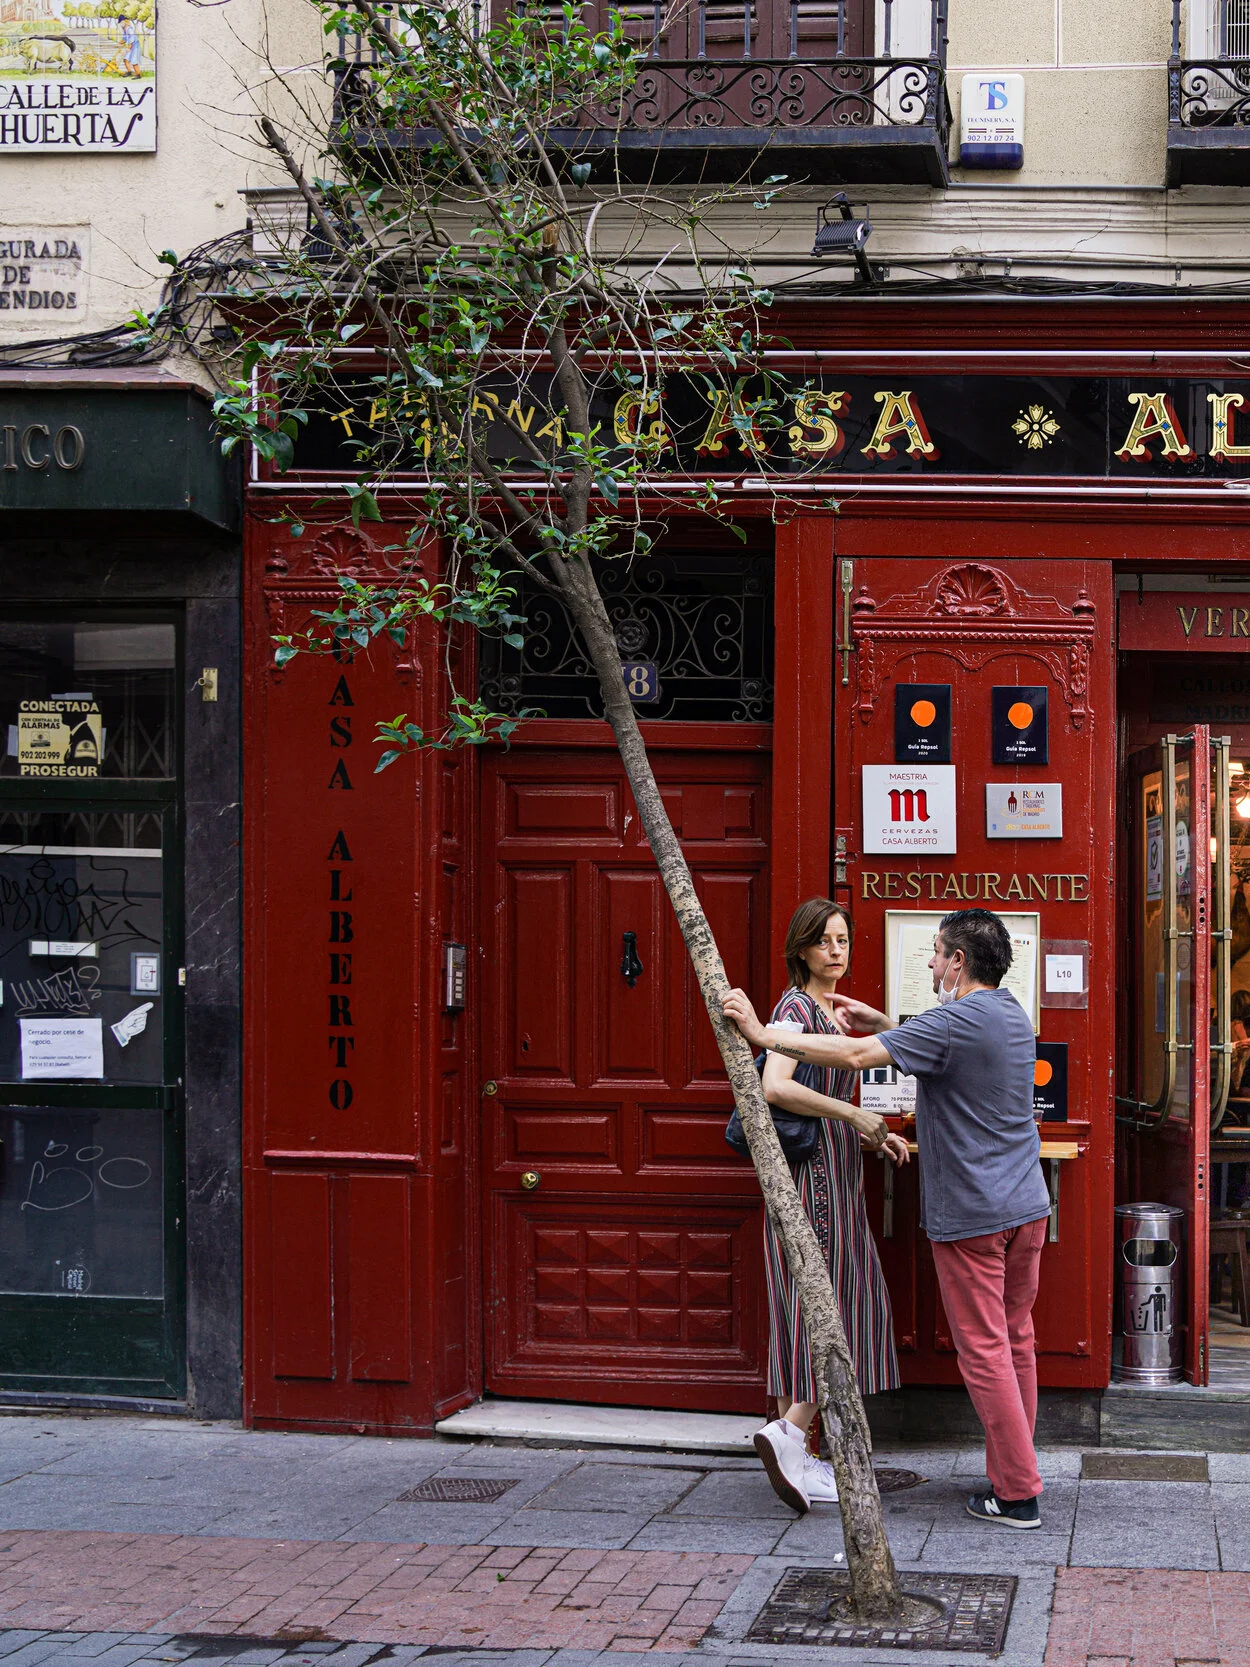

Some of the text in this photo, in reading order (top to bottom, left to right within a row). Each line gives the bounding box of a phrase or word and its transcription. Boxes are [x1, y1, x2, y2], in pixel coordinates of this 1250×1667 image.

[76, 87, 101, 106] DE
[106, 86, 154, 109] LAS
[0, 113, 144, 148] HUERTAS
[2, 265, 31, 286] DE
[613, 390, 938, 459] CASA
[20, 700, 99, 712] CONECTADA
[327, 630, 355, 790] CASA
[20, 751, 60, 760] 902 202 999
[20, 765, 98, 777] PROSEGUR
[1022, 790, 1045, 799] RCM
[861, 871, 1090, 901] RESTAURANTE
[326, 829, 355, 1111] ALBERTO
[1056, 970, 1072, 978] L10
[984, 1498, 1002, 1515] N
